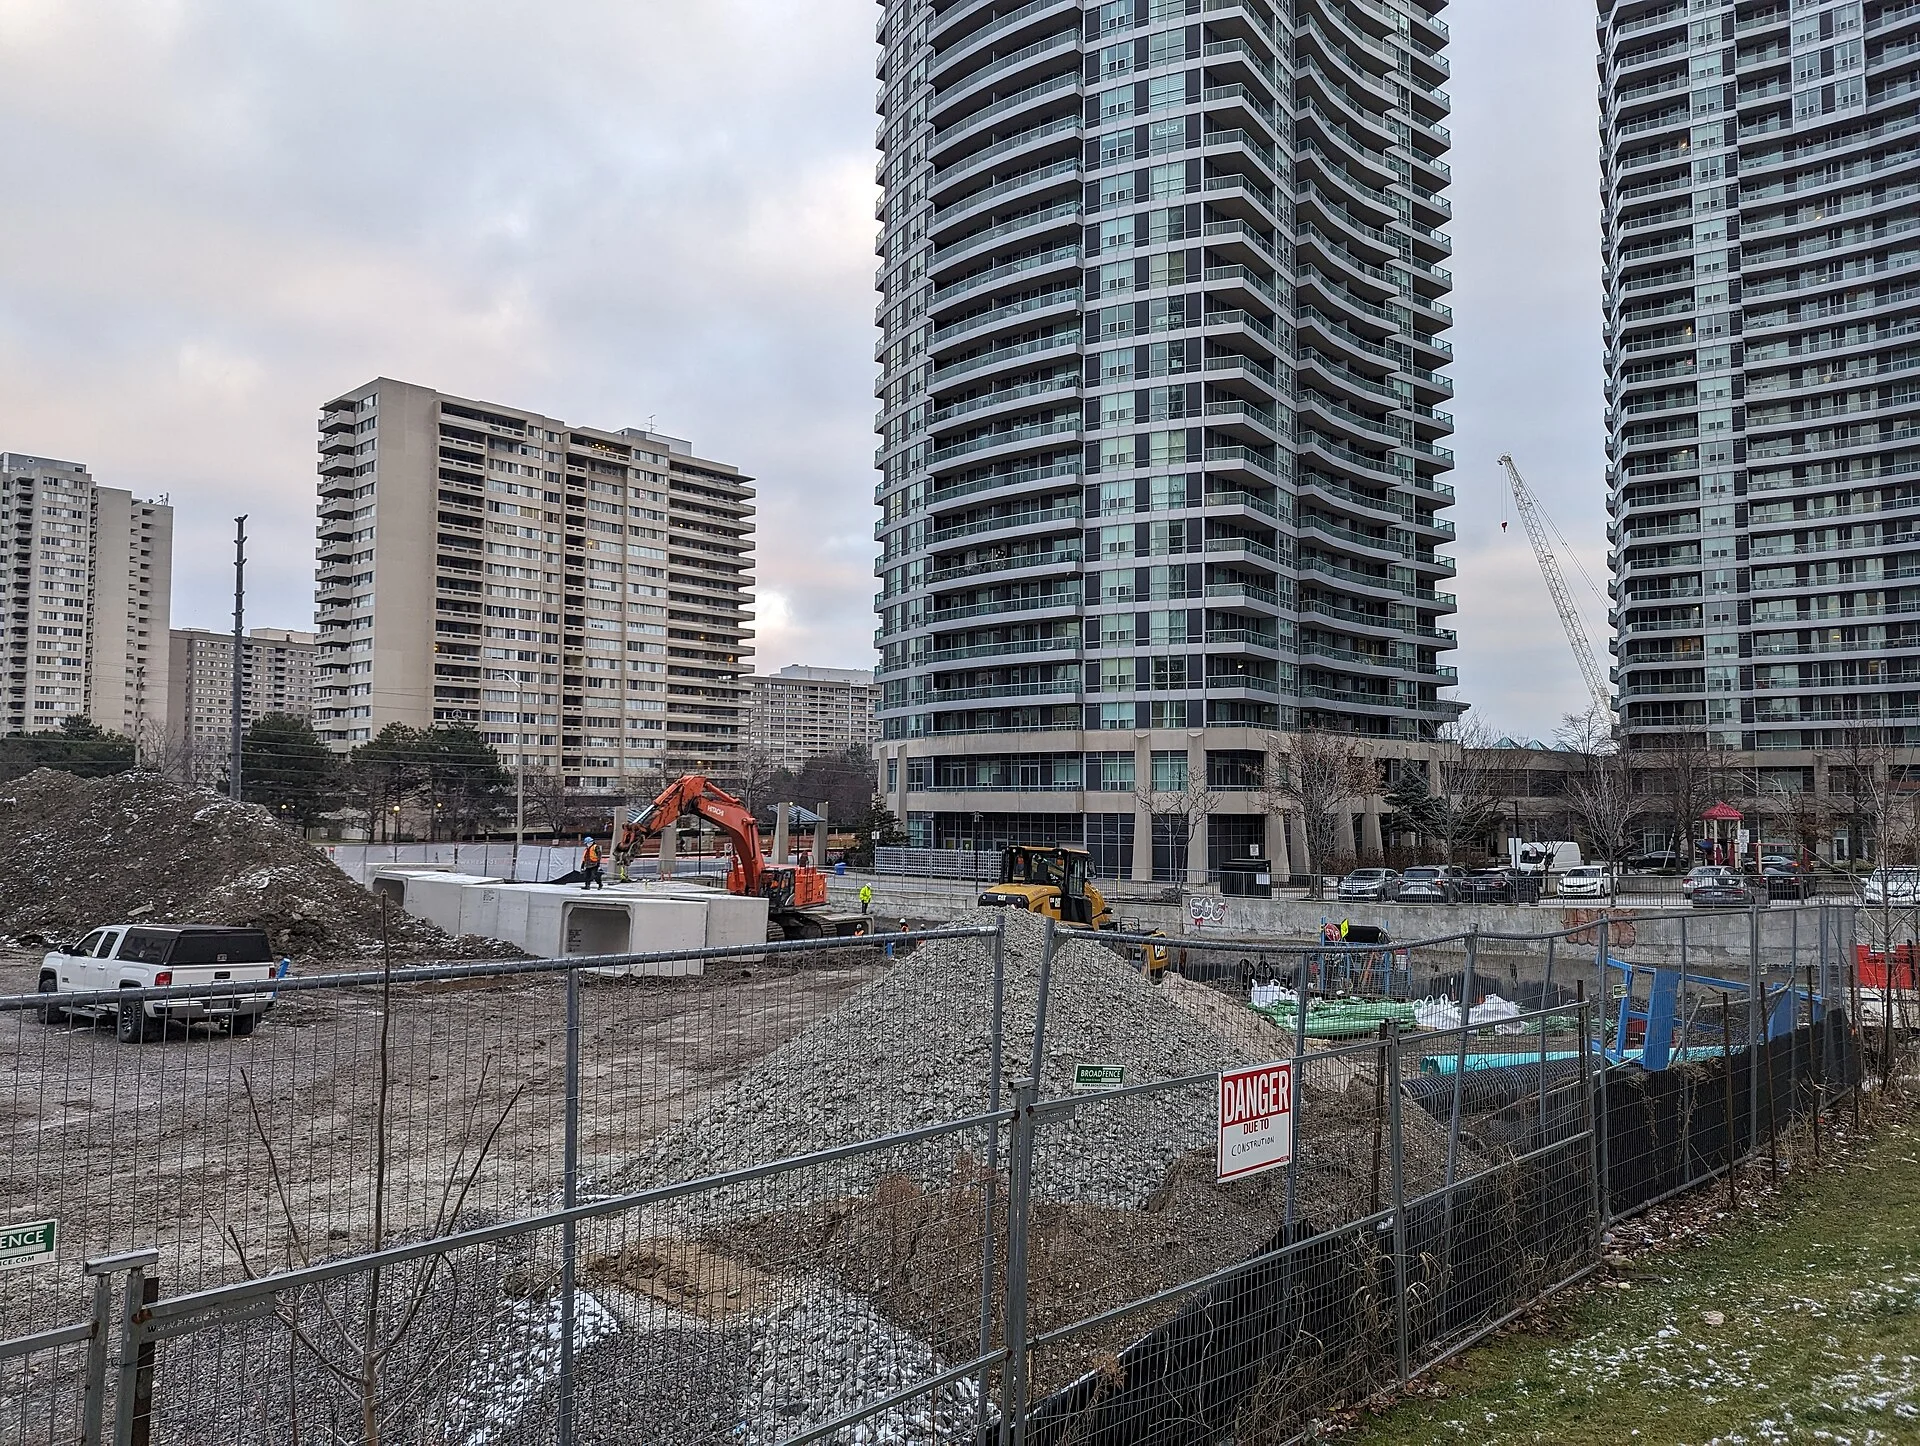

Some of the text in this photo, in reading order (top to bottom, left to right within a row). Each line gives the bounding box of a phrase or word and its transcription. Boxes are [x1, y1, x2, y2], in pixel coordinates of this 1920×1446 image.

[707, 804, 725, 816] HITACHI
[1080, 1069, 1121, 1078] BROADFENCE
[1223, 1070, 1289, 1124] DANGER
[1243, 1117, 1270, 1135] DUE TO
[1231, 1135, 1275, 1157] CONSTRUTION
